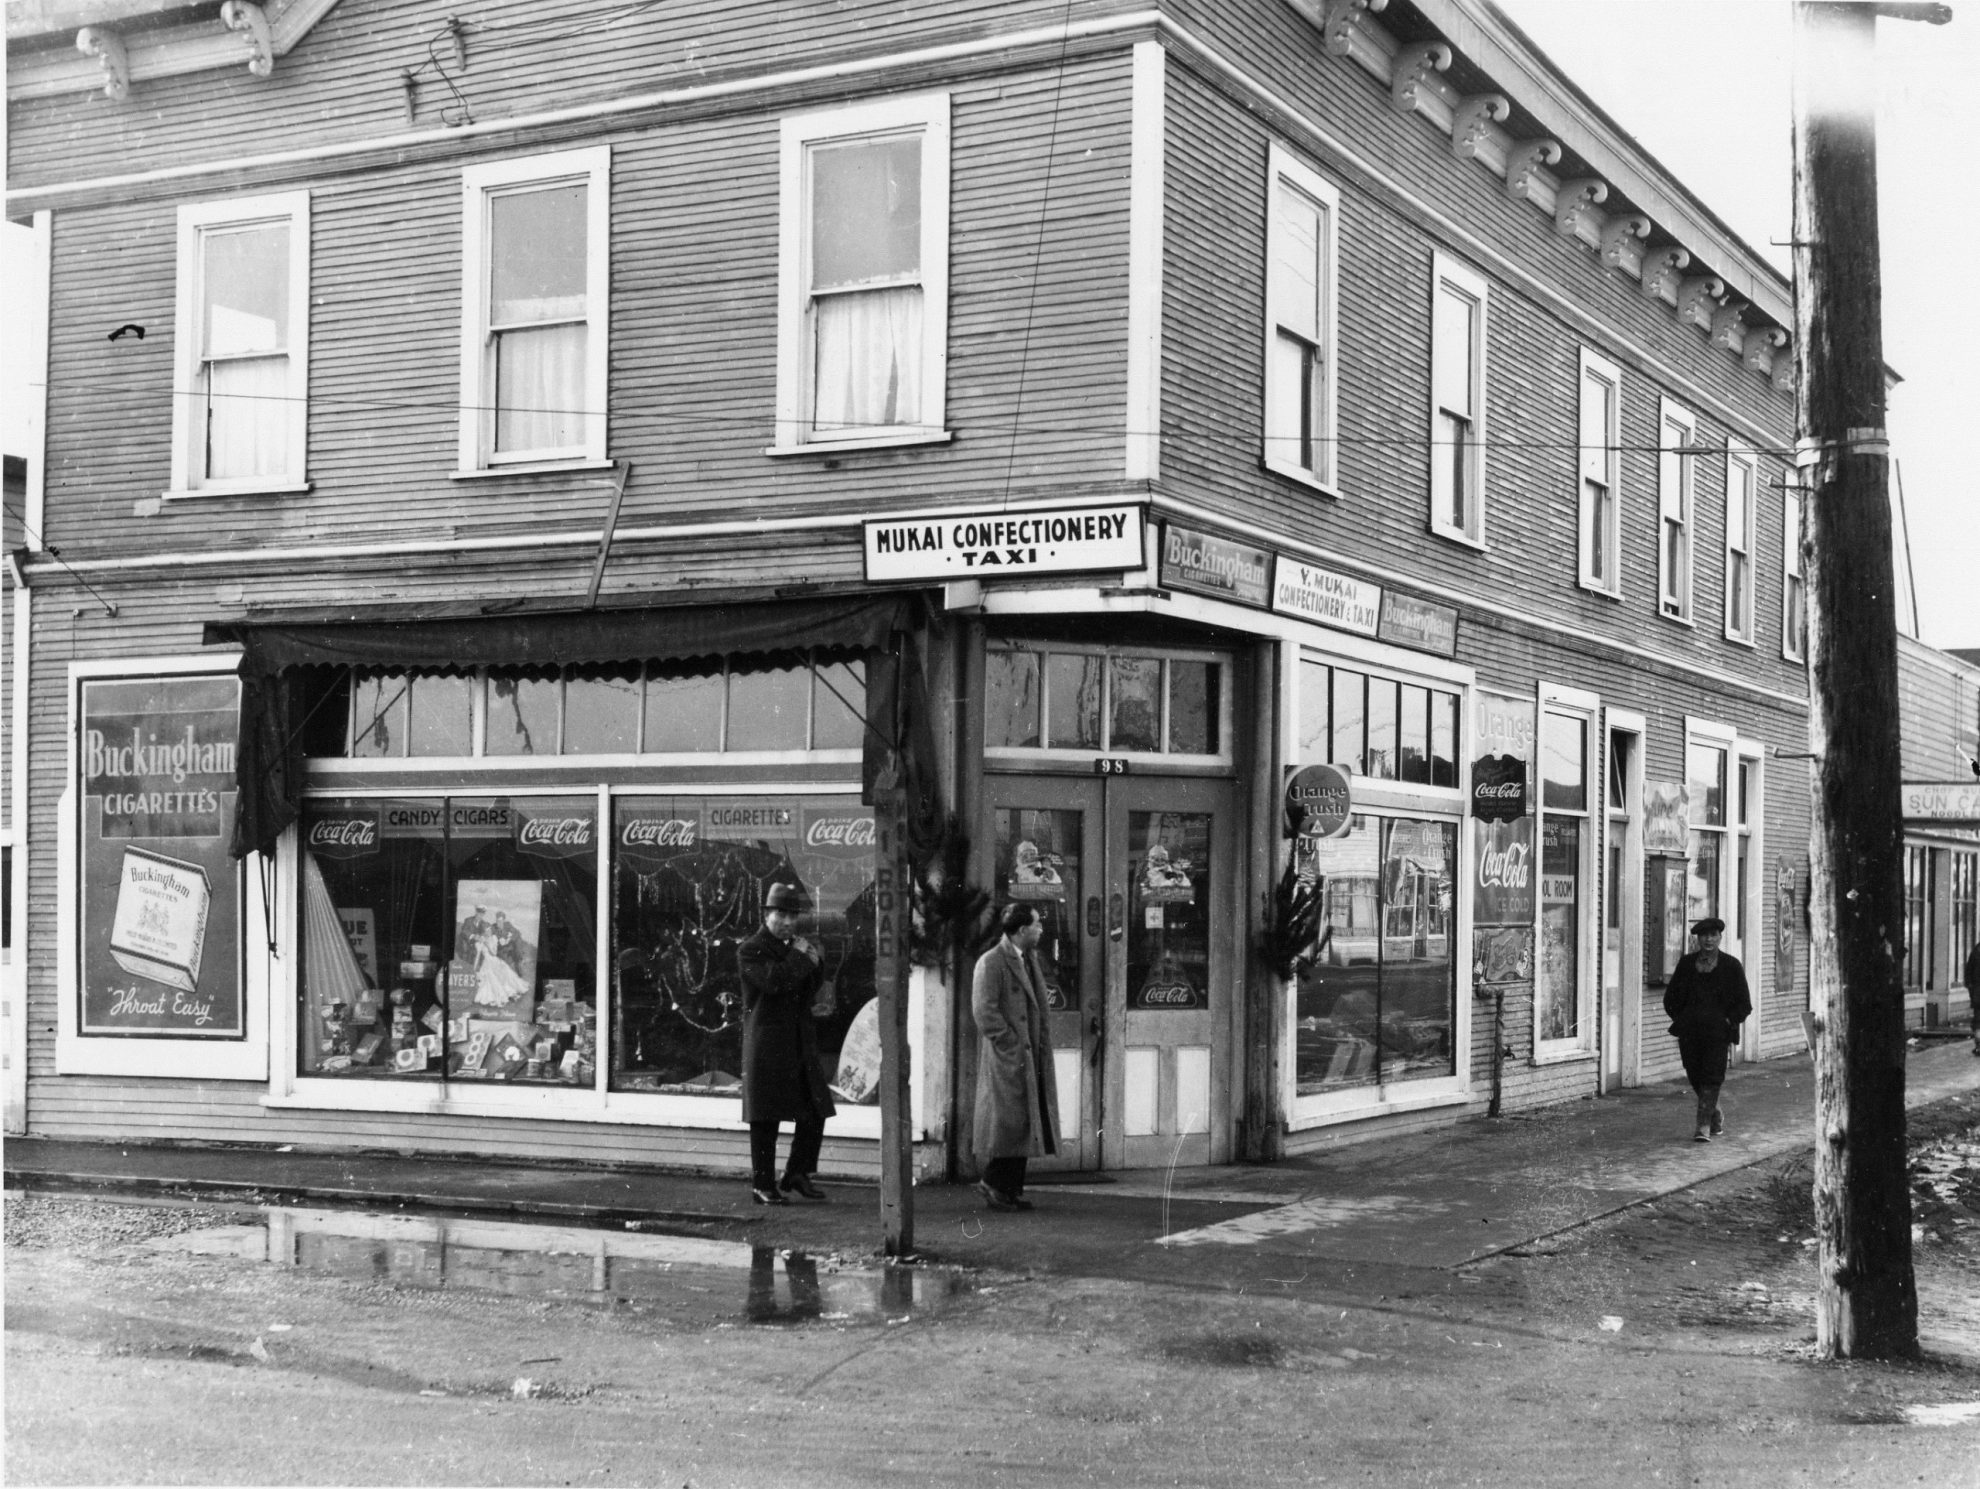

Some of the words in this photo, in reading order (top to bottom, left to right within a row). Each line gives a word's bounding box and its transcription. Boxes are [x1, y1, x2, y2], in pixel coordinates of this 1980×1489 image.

[877, 525, 943, 553] MUKAI
[953, 513, 1127, 548] CONFECTIONERY
[962, 548, 1037, 566] TAXI
[1169, 534, 1265, 588] Buckingham
[1300, 567, 1311, 587] Y.
[1314, 573, 1358, 600] MUKAI
[1279, 583, 1346, 620] CONFECTIONERY
[1354, 604, 1375, 628] TAXI
[1384, 598, 1453, 641] Buckingham
[87, 725, 236, 784] Buckingham
[104, 790, 218, 815] CIGARETTES
[1475, 782, 1522, 798] Coca-Cola
[1910, 794, 1948, 811] SUN
[389, 810, 440, 826] CANDY
[453, 809, 508, 825] CIGARS
[711, 808, 791, 826] CIGARETTES
[1303, 802, 1344, 818] rush
[309, 819, 377, 846] Coca-Cola
[520, 817, 593, 845] Coca-Cola
[622, 818, 697, 846] Coca-Cola
[1478, 839, 1530, 888] Coca-Cola
[131, 867, 191, 899] Buckingham
[1554, 879, 1573, 898] ROOM
[438, 973, 475, 988] PAYER'S
